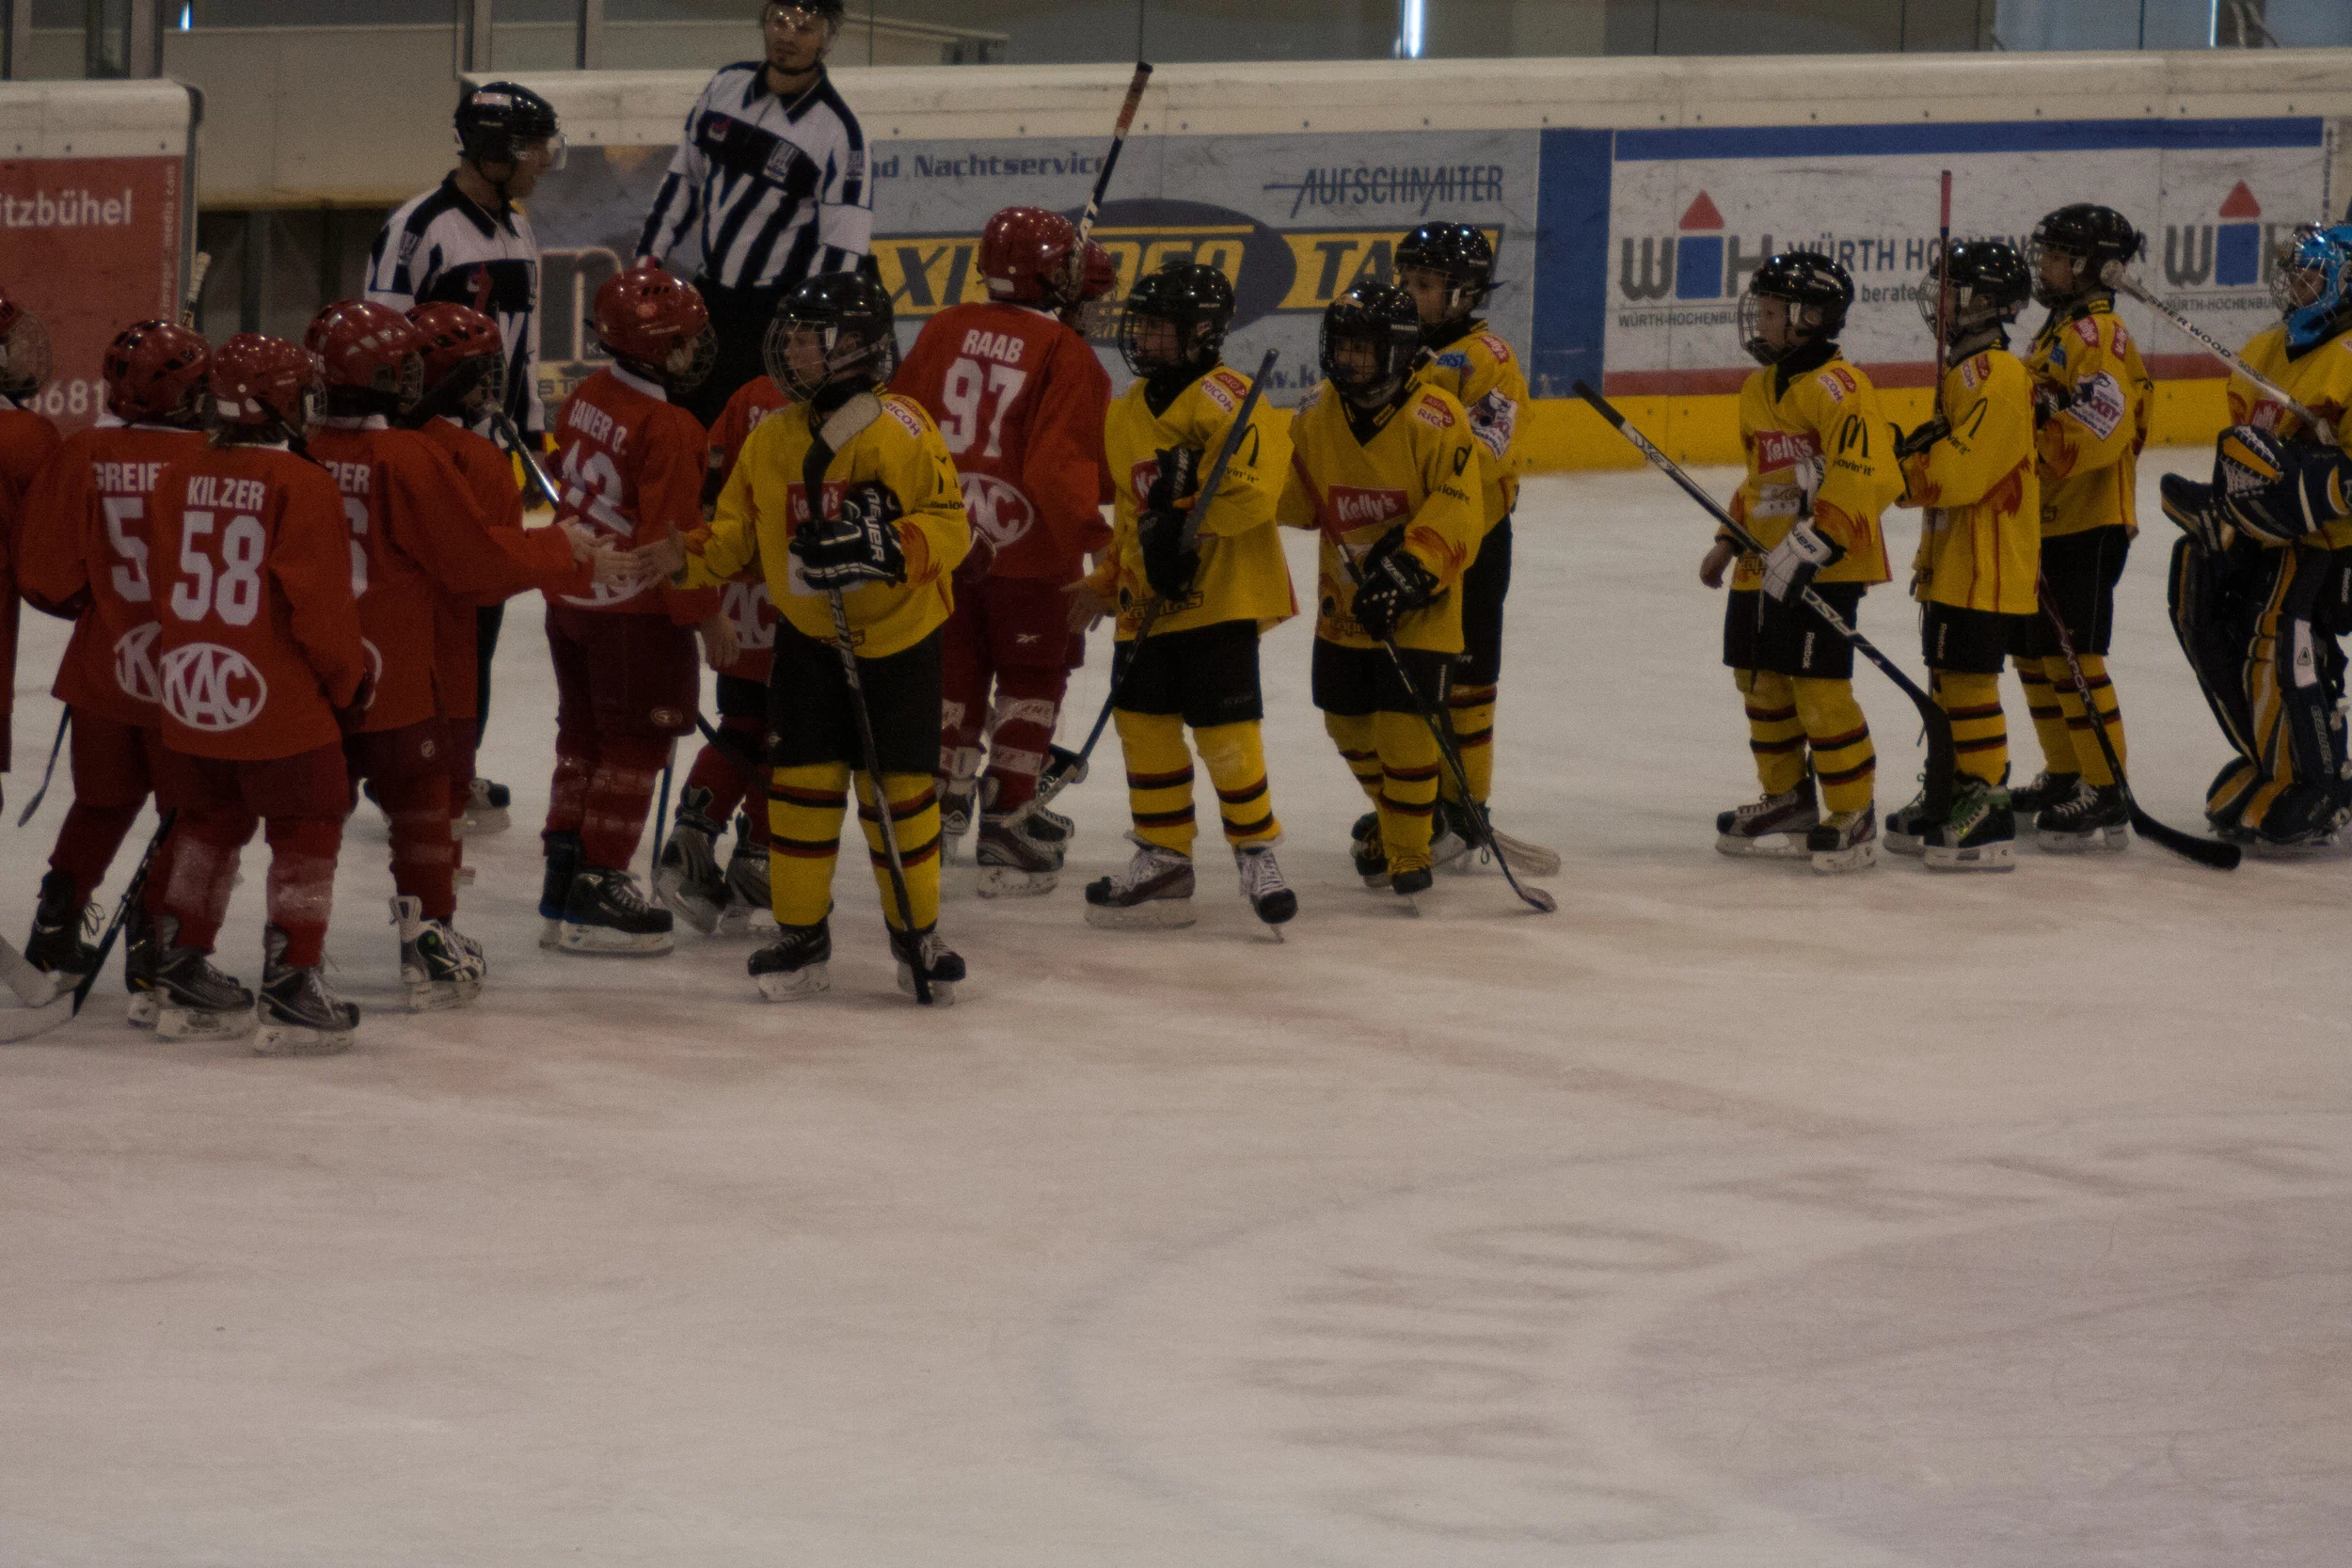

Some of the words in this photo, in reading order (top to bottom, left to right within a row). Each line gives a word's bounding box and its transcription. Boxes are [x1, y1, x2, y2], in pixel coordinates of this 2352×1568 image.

[0, 189, 134, 229] tzbühel
[1290, 165, 1504, 218] AUFSCHNAITER
[961, 327, 1025, 365] RAAB
[940, 357, 1028, 459] 97
[1200, 377, 1235, 414] RICOH
[188, 474, 267, 512] KILZER
[1336, 492, 1399, 522] Kelly's
[170, 511, 267, 626] 58
[161, 643, 265, 731] KAC
